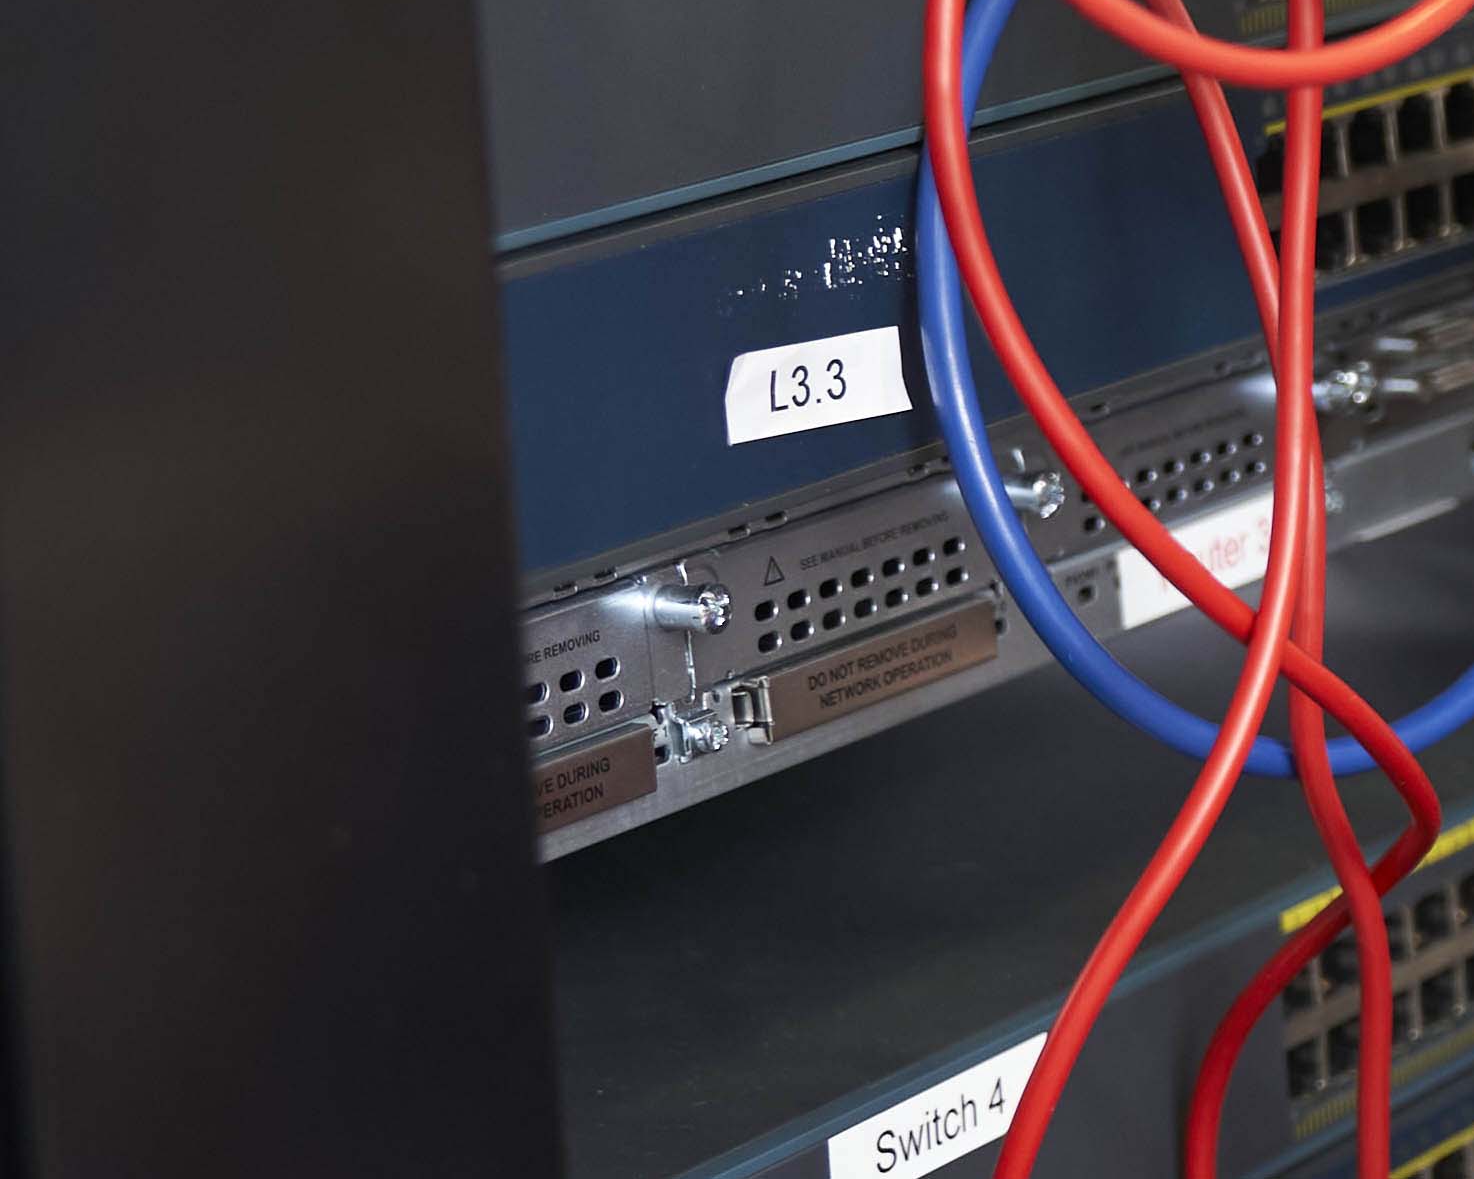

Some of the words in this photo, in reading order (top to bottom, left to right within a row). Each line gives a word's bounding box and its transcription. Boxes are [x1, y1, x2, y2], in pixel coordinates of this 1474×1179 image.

[769, 358, 848, 413] L3.3
[544, 630, 601, 661] REMOVING
[807, 672, 828, 691] DO
[830, 659, 857, 682] NOT
[858, 643, 910, 671] REMOVE
[819, 674, 881, 709] NETWORK
[883, 649, 953, 686] OPERATION
[557, 756, 611, 790] DURING
[543, 782, 604, 819] ERATION
[875, 1092, 978, 1174] Switch
[987, 1075, 1006, 1114] 4
